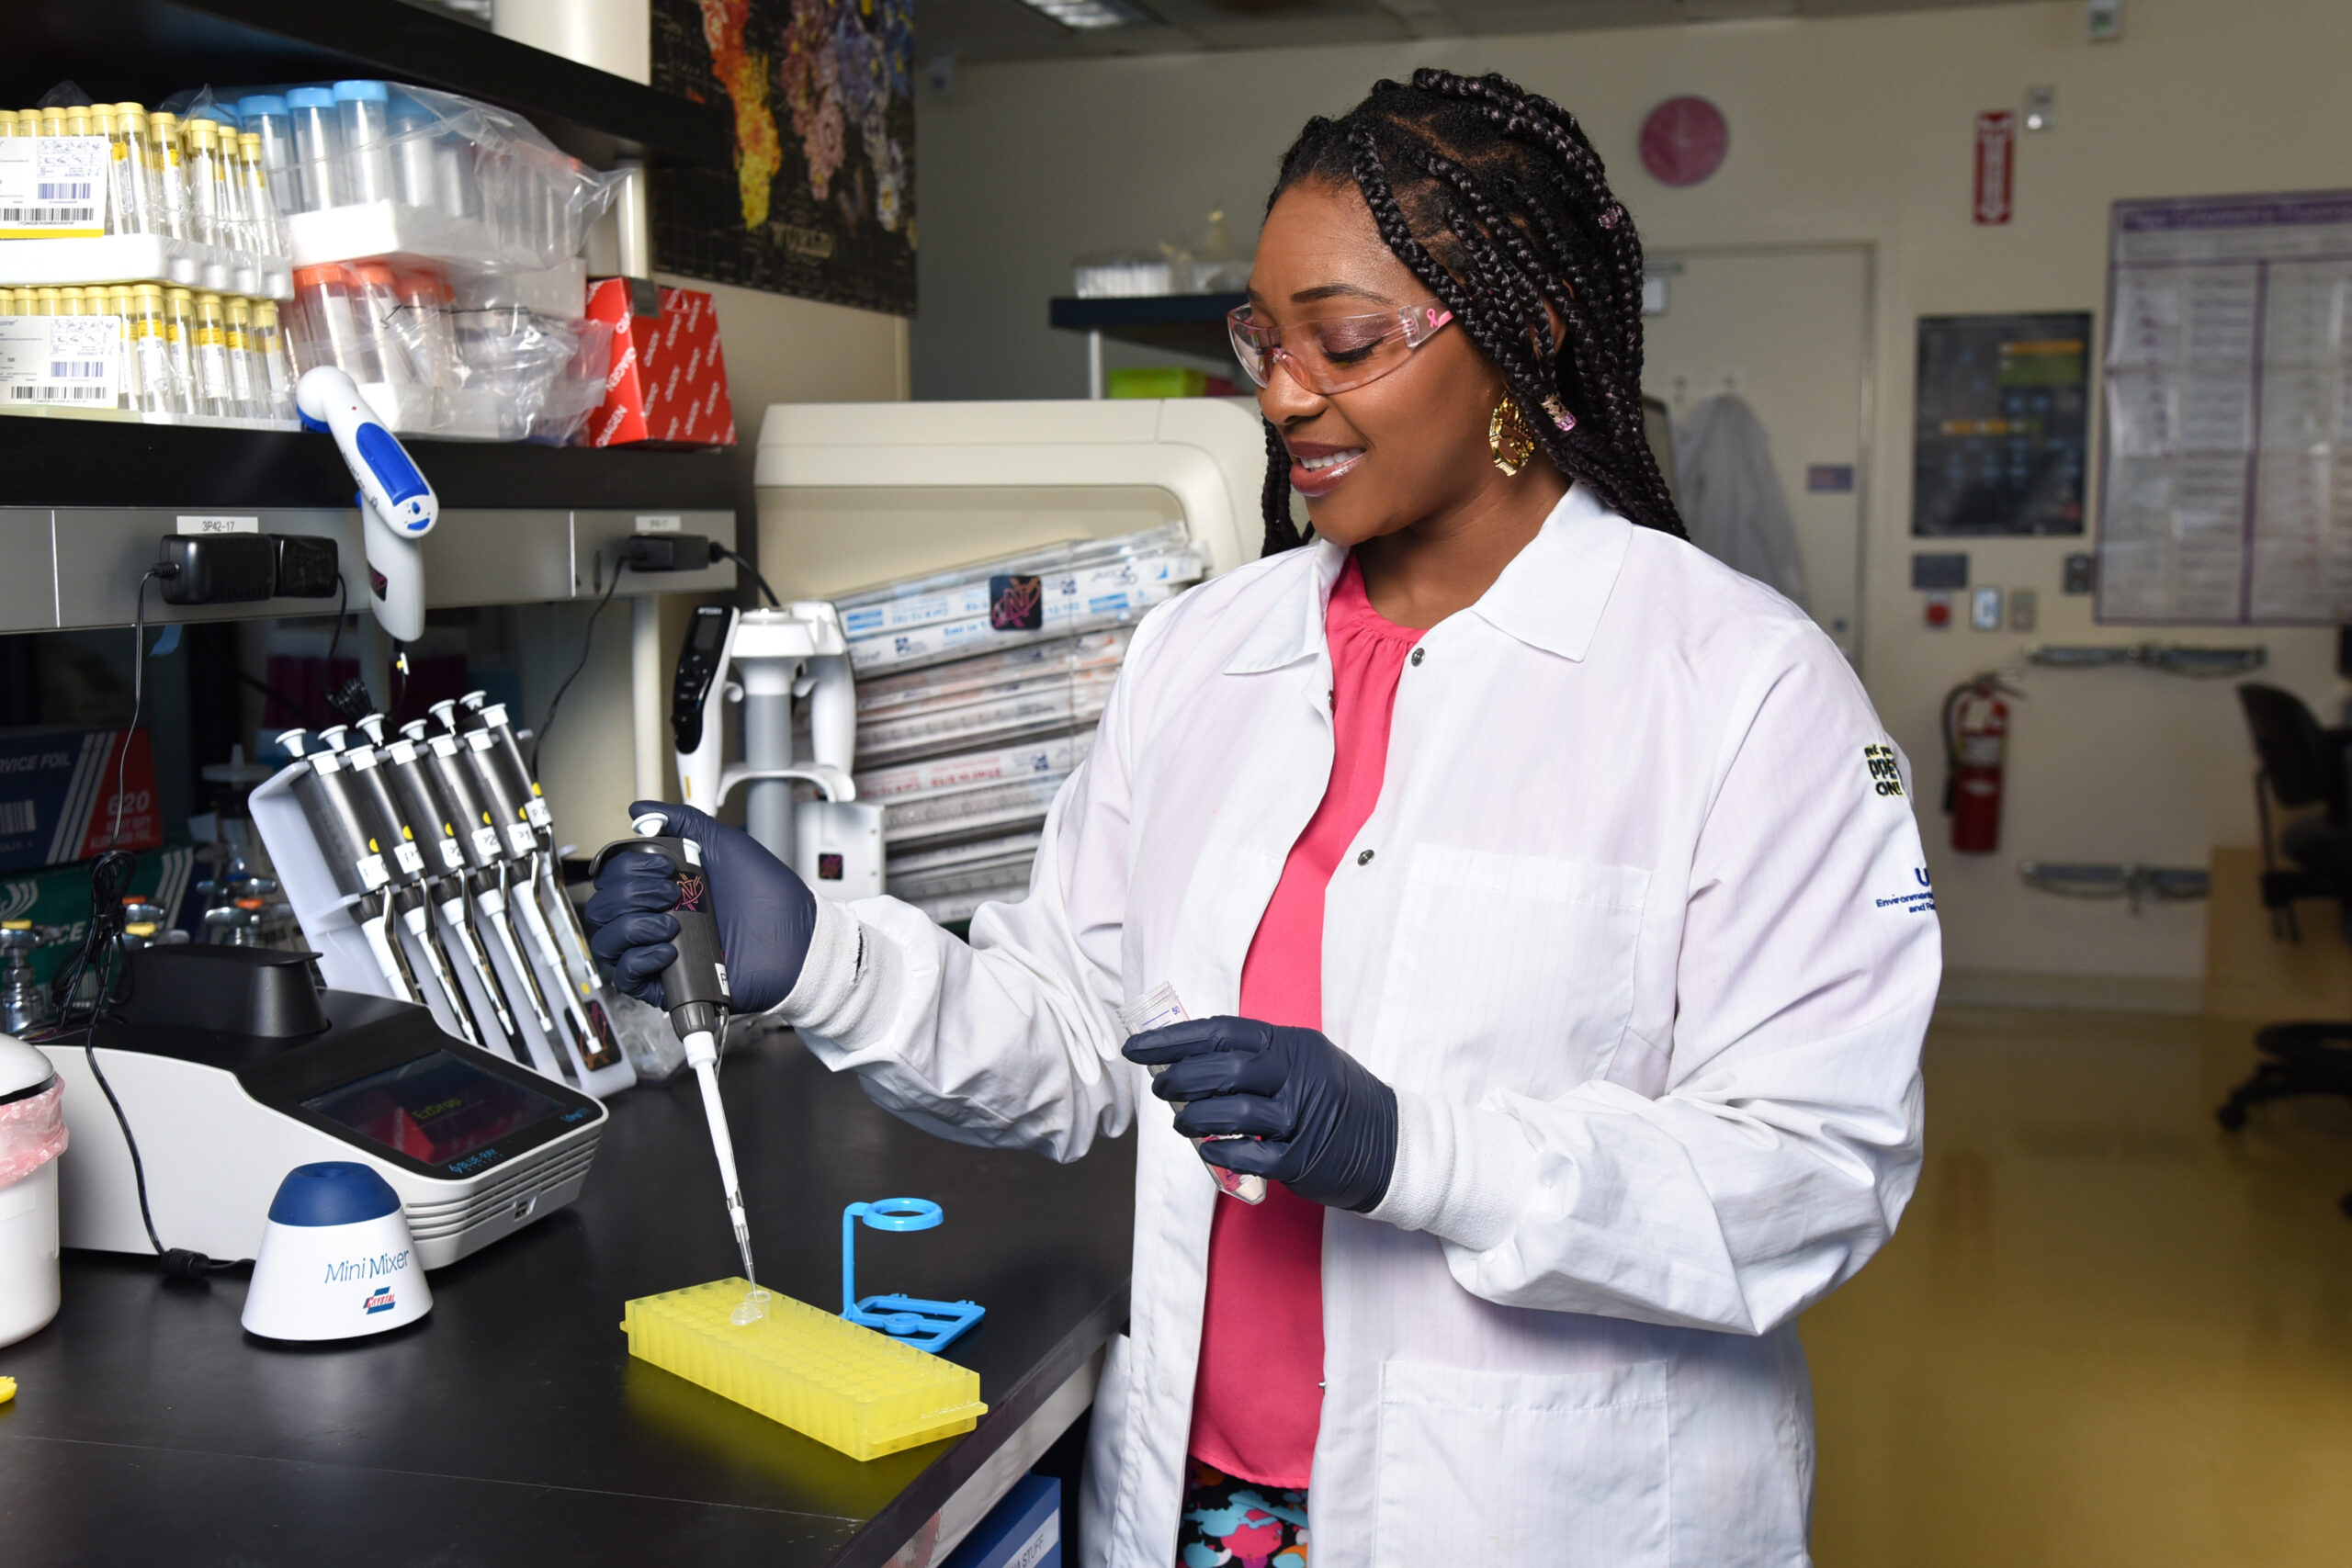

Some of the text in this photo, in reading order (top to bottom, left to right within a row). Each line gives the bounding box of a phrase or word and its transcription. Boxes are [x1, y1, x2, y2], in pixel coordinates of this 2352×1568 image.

[596, 404, 628, 447] QIAGEN
[1908, 902, 1926, 913] and
[324, 1249, 410, 1284] Mini Mixer
